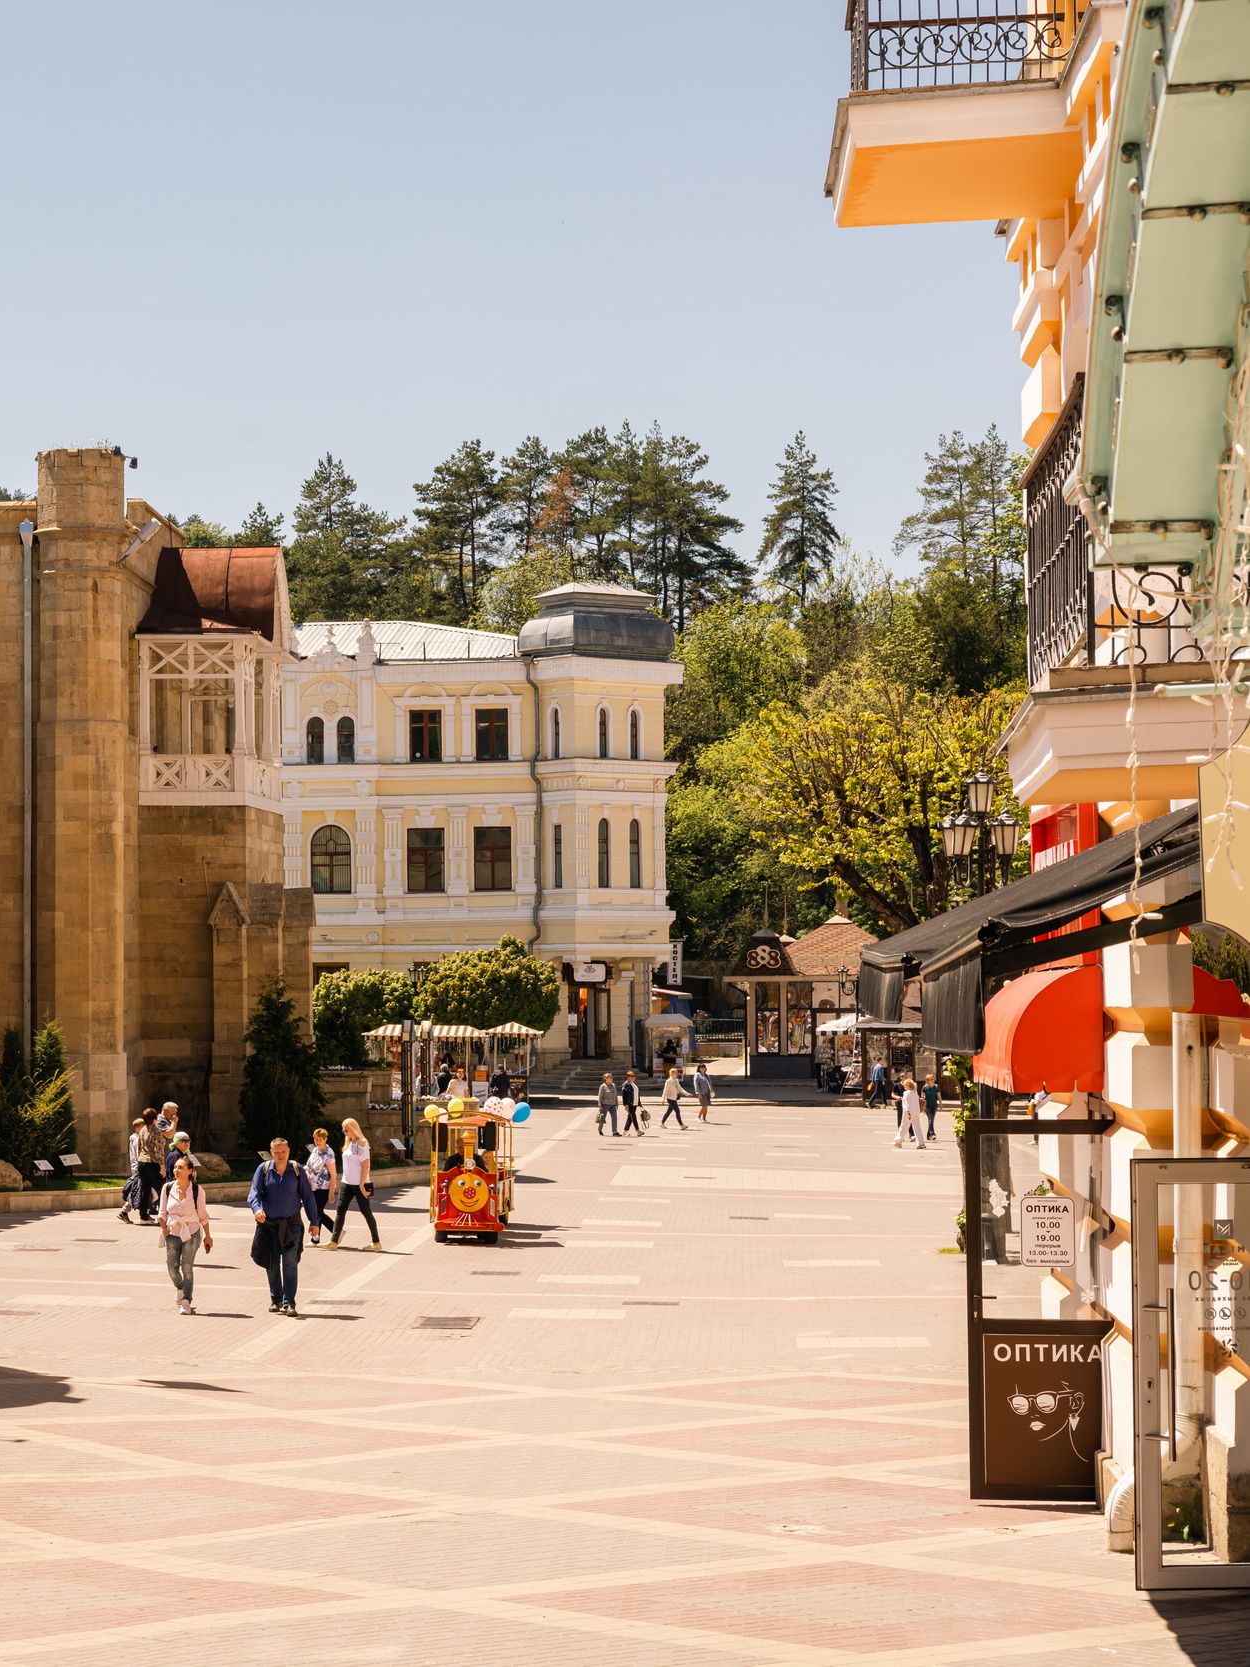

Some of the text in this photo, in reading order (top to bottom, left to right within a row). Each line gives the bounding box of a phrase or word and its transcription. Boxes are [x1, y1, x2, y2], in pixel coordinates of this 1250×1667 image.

[747, 945, 781, 968] 888
[1026, 1205, 1069, 1213] ОПТИКА
[1036, 1221, 1060, 1229] 10.00
[1036, 1234, 1060, 1242] 19.00
[993, 1343, 1102, 1363] ОПТИКА
